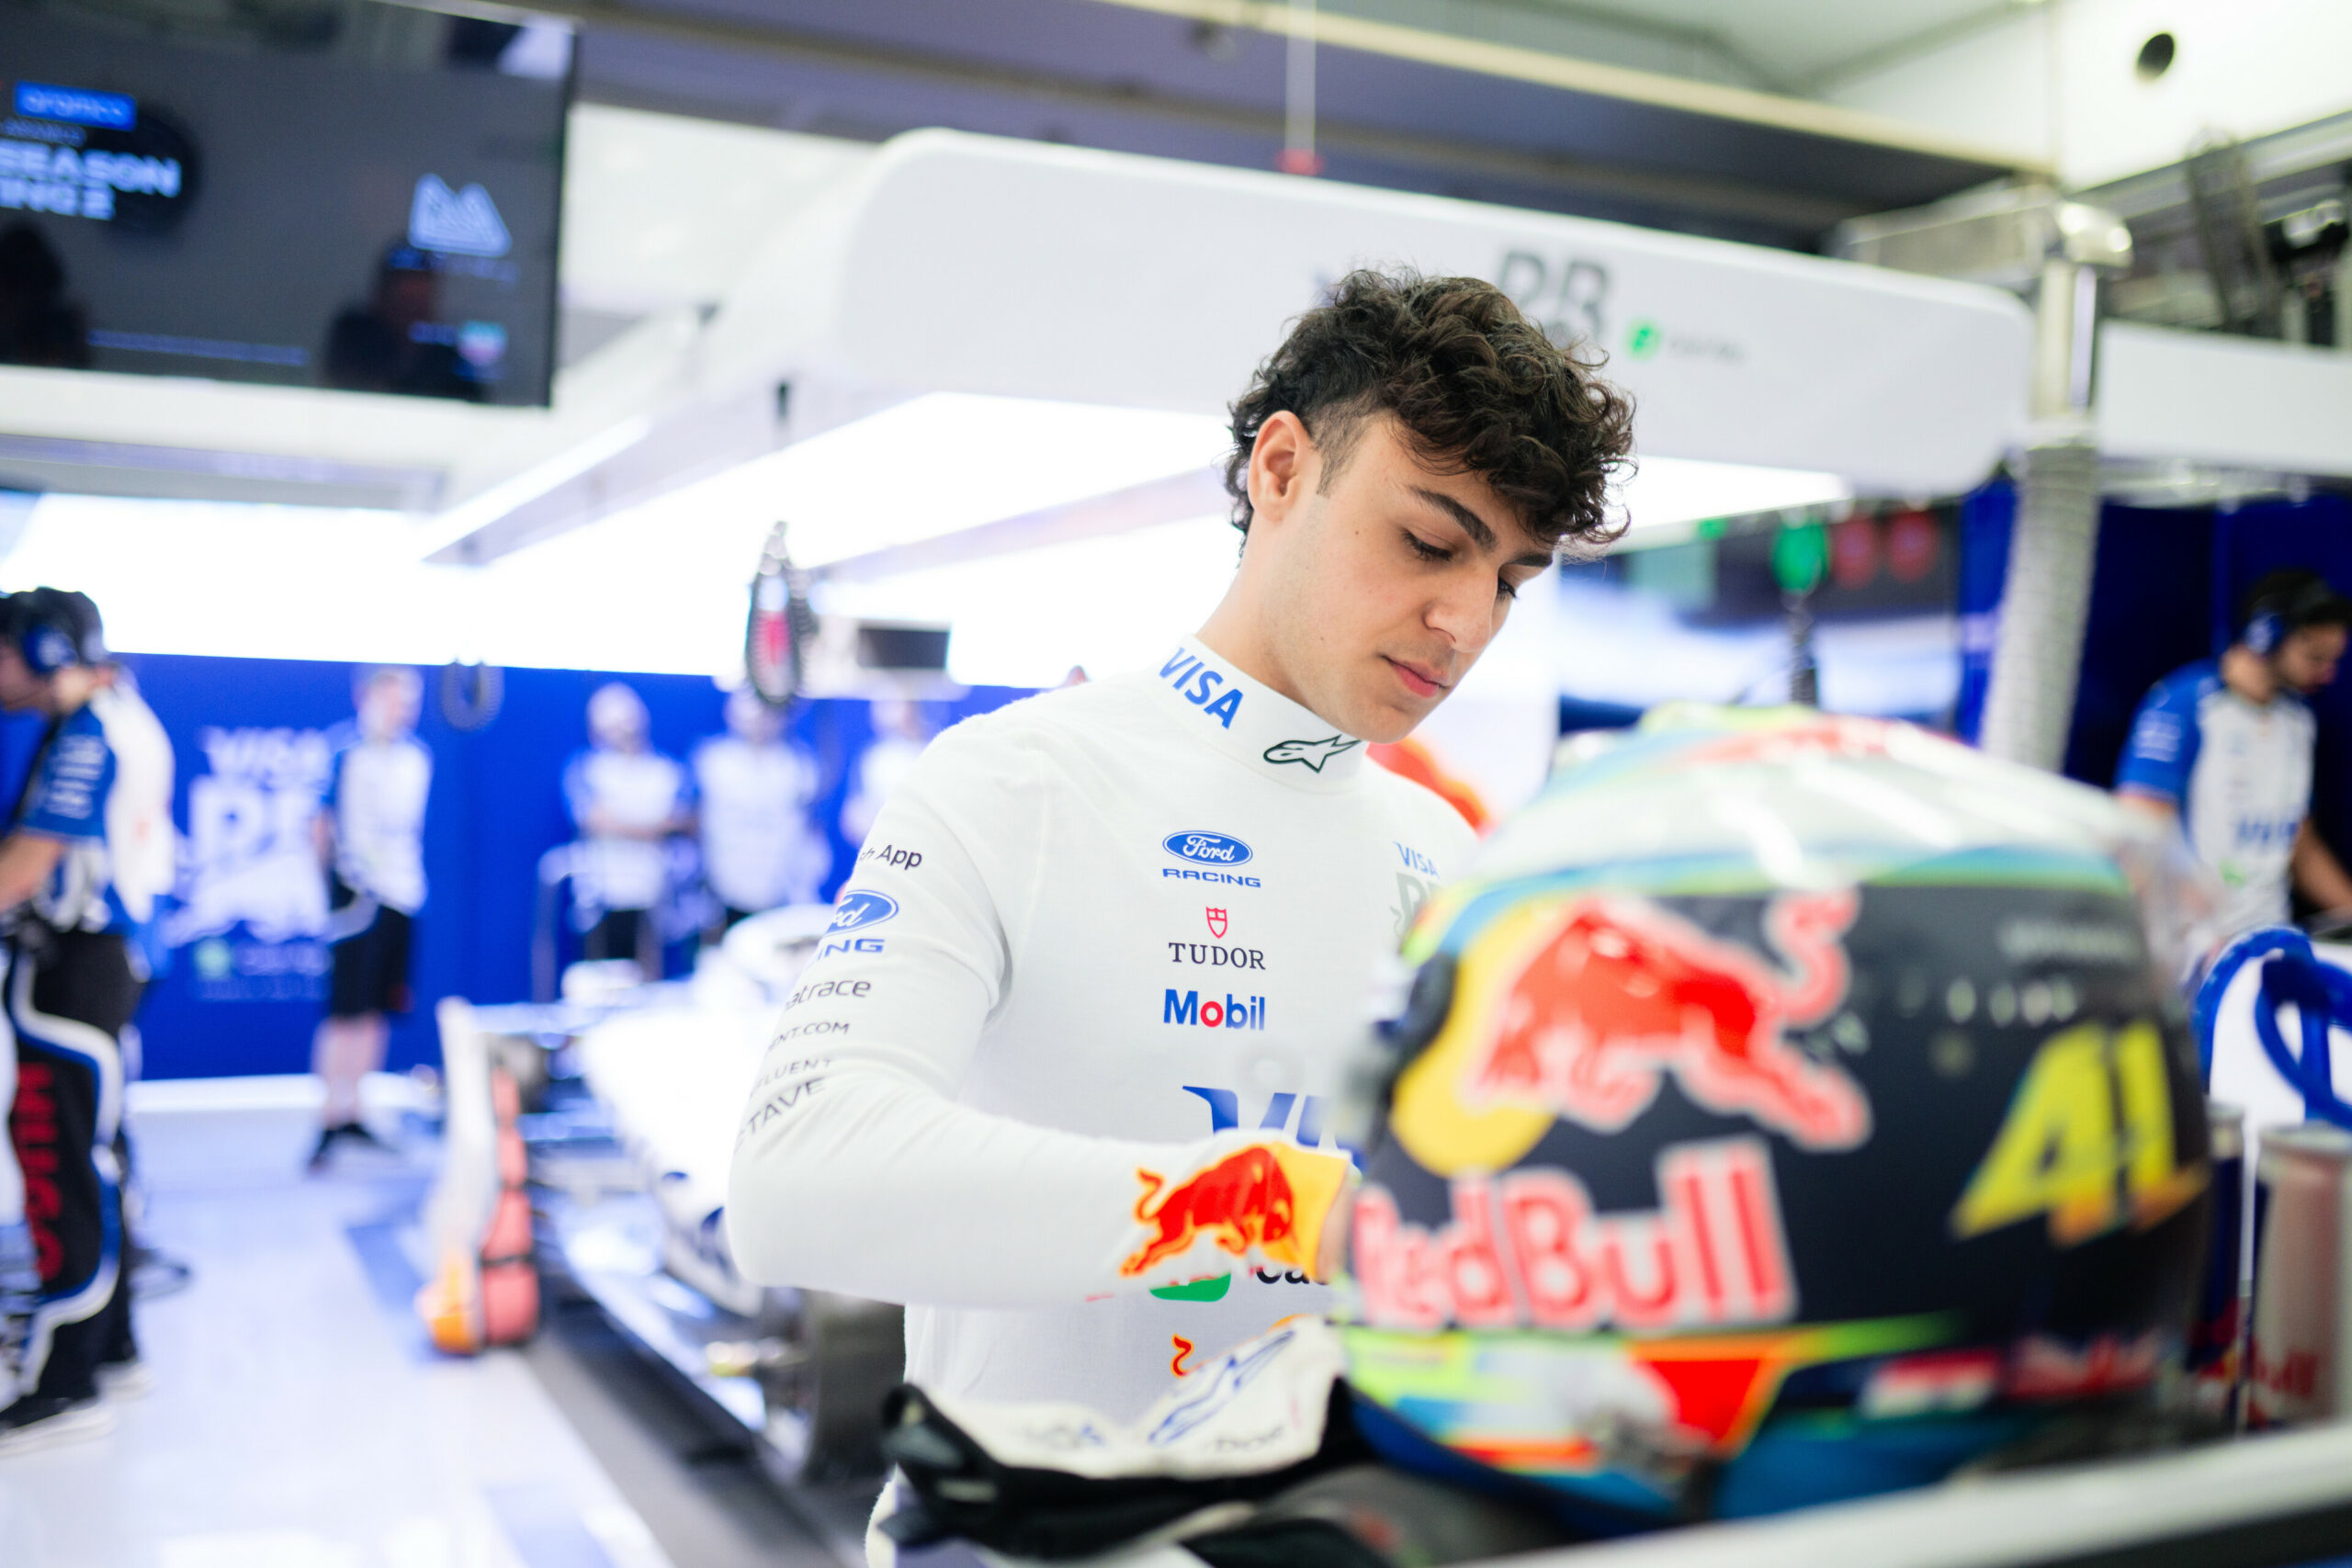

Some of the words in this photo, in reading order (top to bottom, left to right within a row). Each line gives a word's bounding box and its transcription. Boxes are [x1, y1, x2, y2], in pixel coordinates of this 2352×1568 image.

[1159, 647, 1243, 730] VISA
[875, 844, 922, 871] App
[1182, 834, 1235, 862] Ford
[1393, 840, 1441, 881] VISA
[1162, 868, 1261, 888] RACING
[1169, 942, 1266, 970] TUDOR
[1163, 988, 1265, 1031] Mobil
